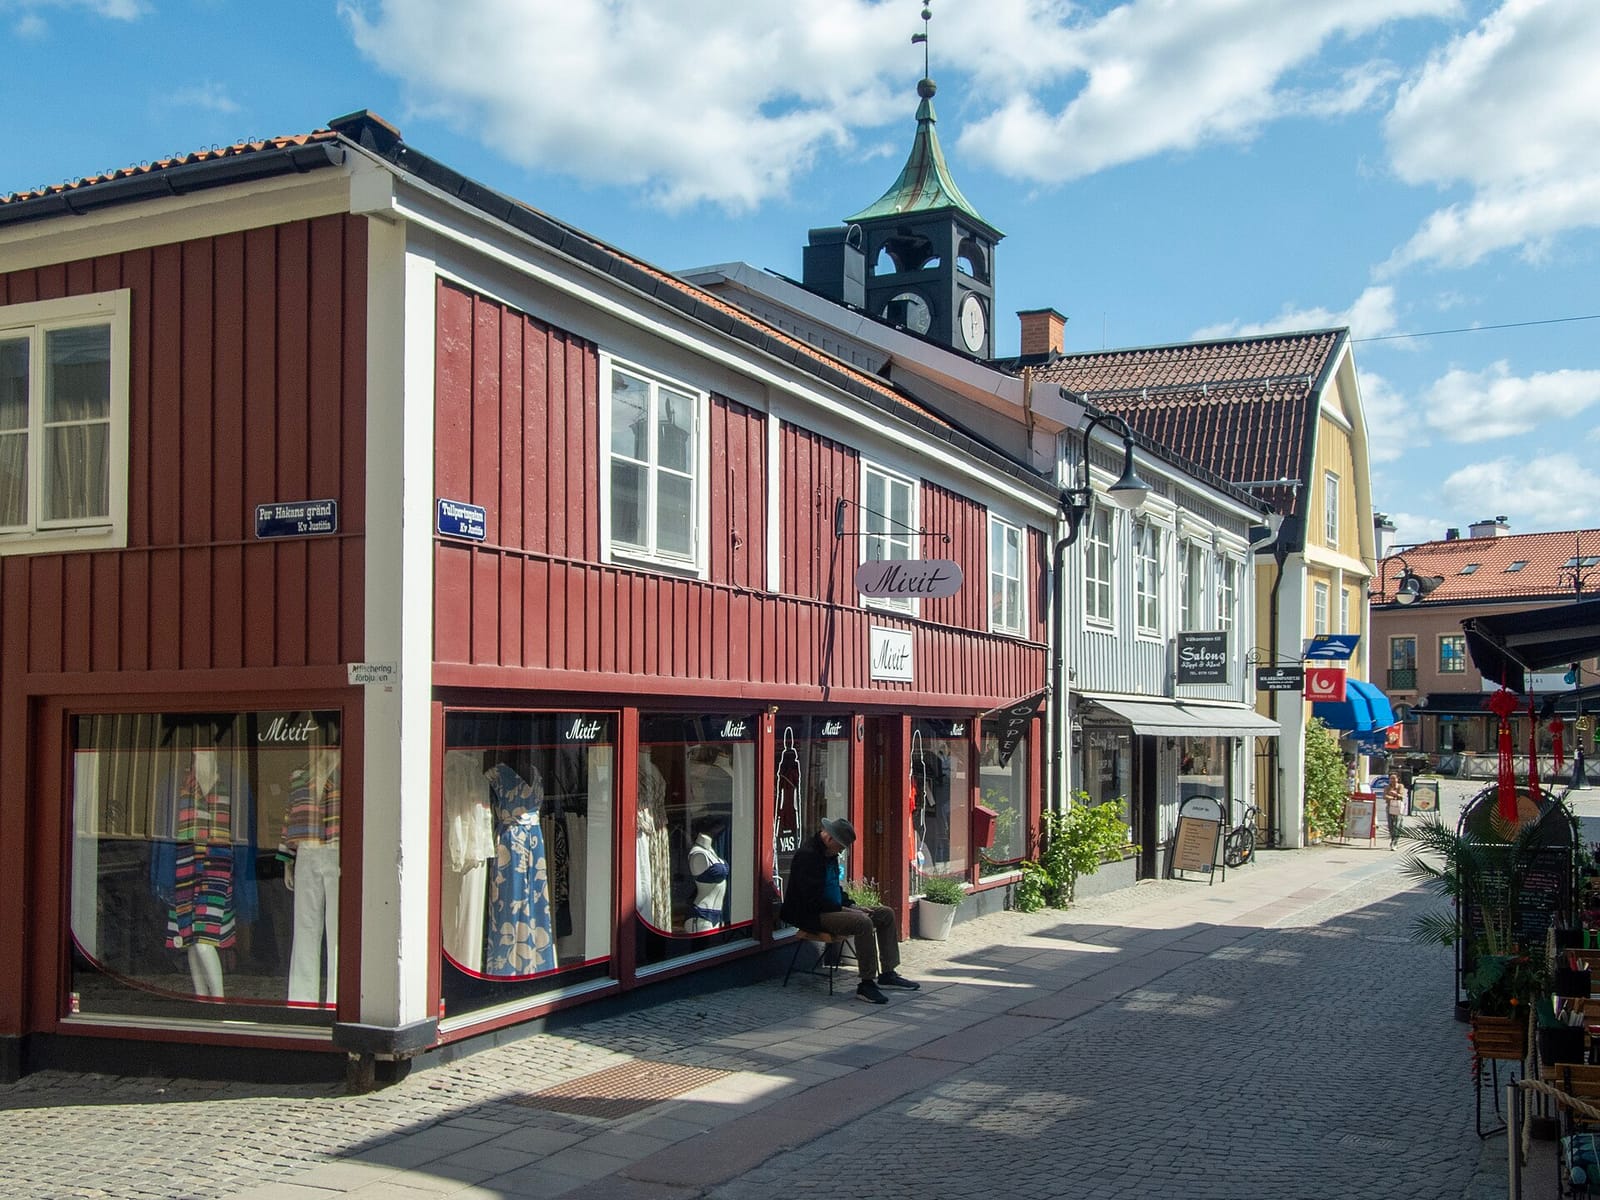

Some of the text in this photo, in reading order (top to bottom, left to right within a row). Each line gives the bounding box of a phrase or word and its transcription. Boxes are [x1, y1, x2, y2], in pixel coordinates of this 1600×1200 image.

[259, 508, 273, 520] Per
[306, 503, 331, 521] gränd
[297, 521, 308, 532] Kv
[865, 564, 951, 593] Mixit
[873, 639, 910, 671] Mixit
[1179, 646, 1226, 664] Salong
[257, 717, 319, 742] Mixit
[565, 718, 601, 740] Mixit
[720, 719, 746, 738] Mixit
